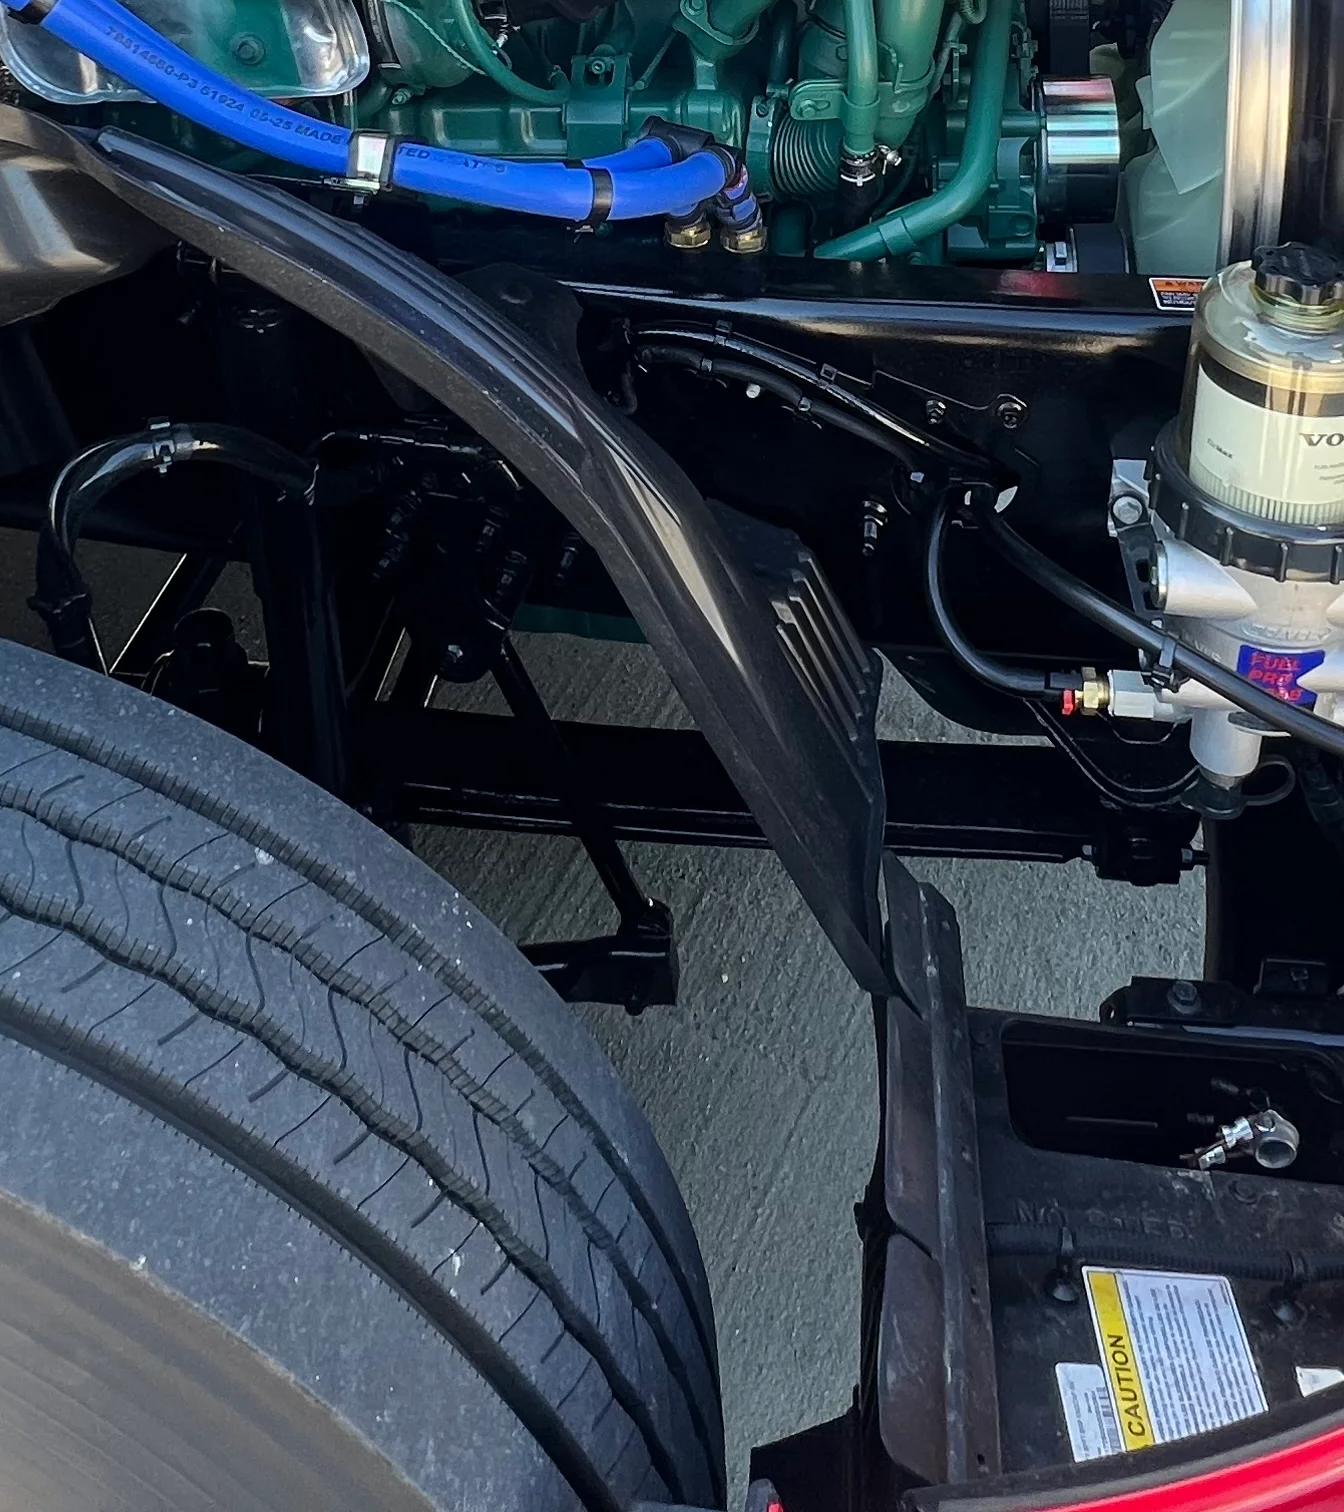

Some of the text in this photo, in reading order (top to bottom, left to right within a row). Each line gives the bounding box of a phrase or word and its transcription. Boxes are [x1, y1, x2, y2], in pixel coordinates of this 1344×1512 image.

[294, 123, 341, 146] MADE
[1249, 651, 1300, 670] FUEL
[1106, 1333, 1146, 1437] CAUTION
